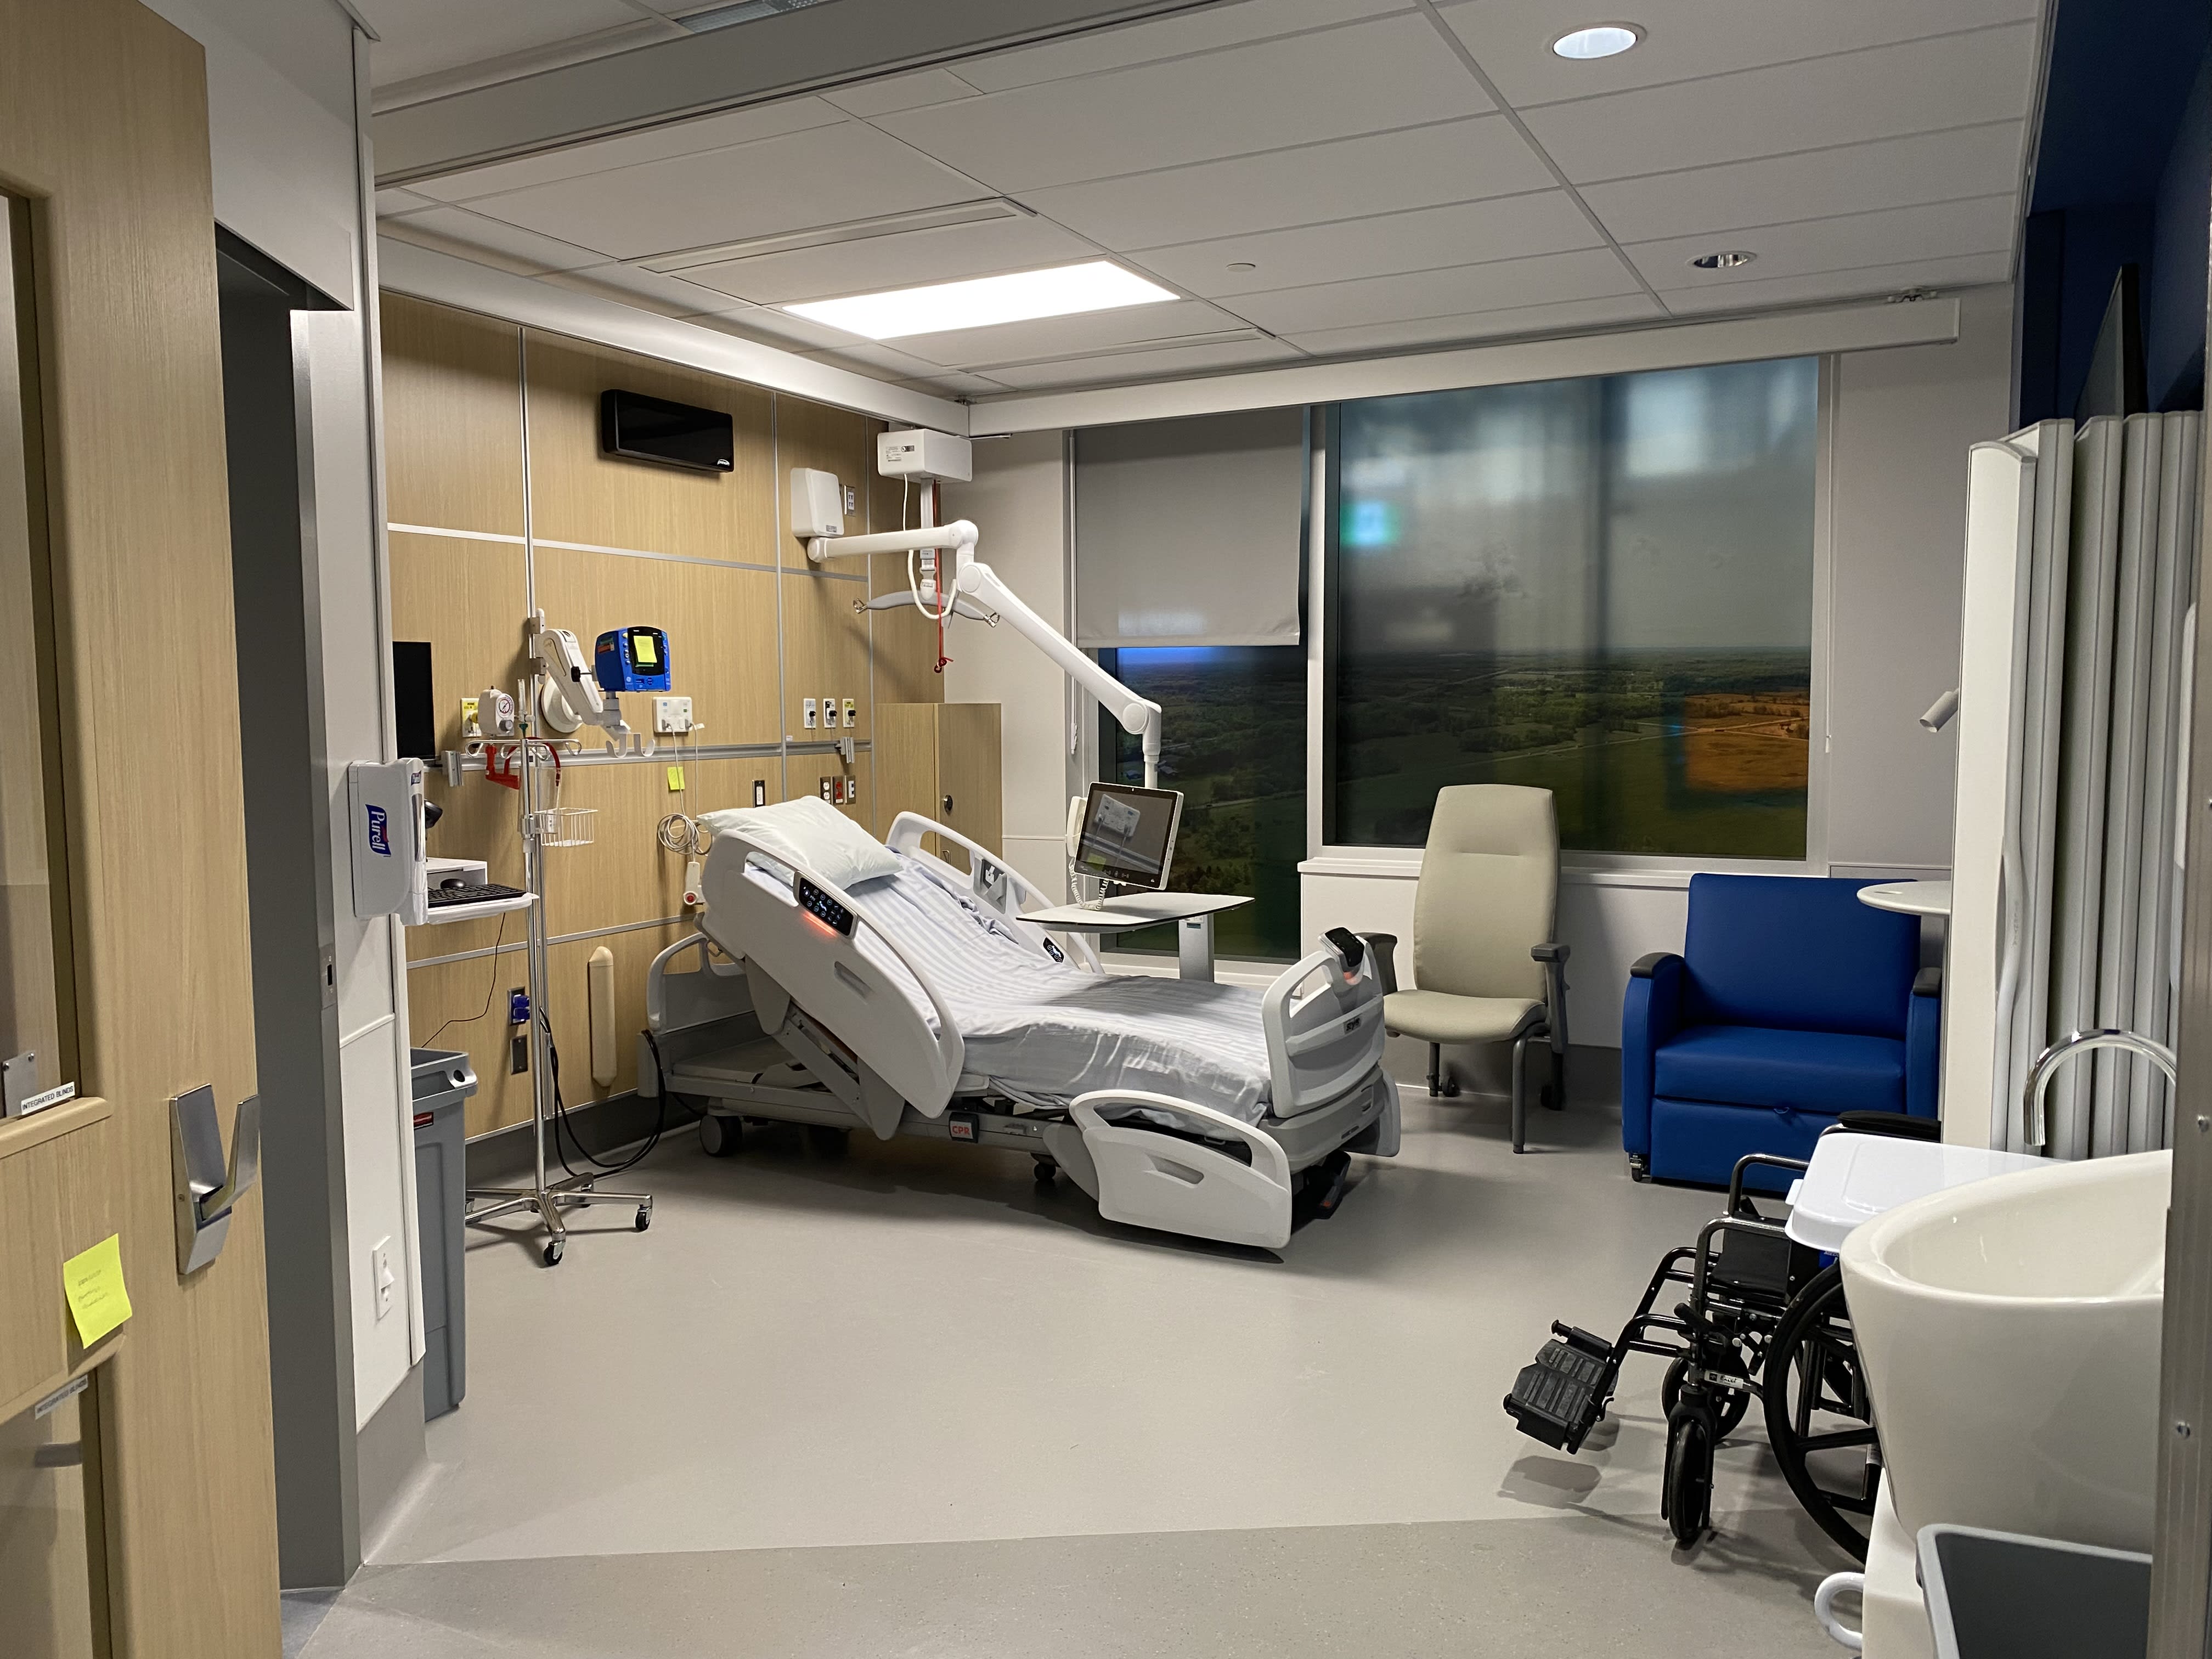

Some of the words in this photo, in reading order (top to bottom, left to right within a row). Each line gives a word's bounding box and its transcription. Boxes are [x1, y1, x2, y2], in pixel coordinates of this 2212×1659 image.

[371, 811, 386, 851] Purell
[22, 1093, 55, 1110] INTEGRATED
[56, 1086, 74, 1098] BLINDS
[952, 1125, 970, 1136] CPR
